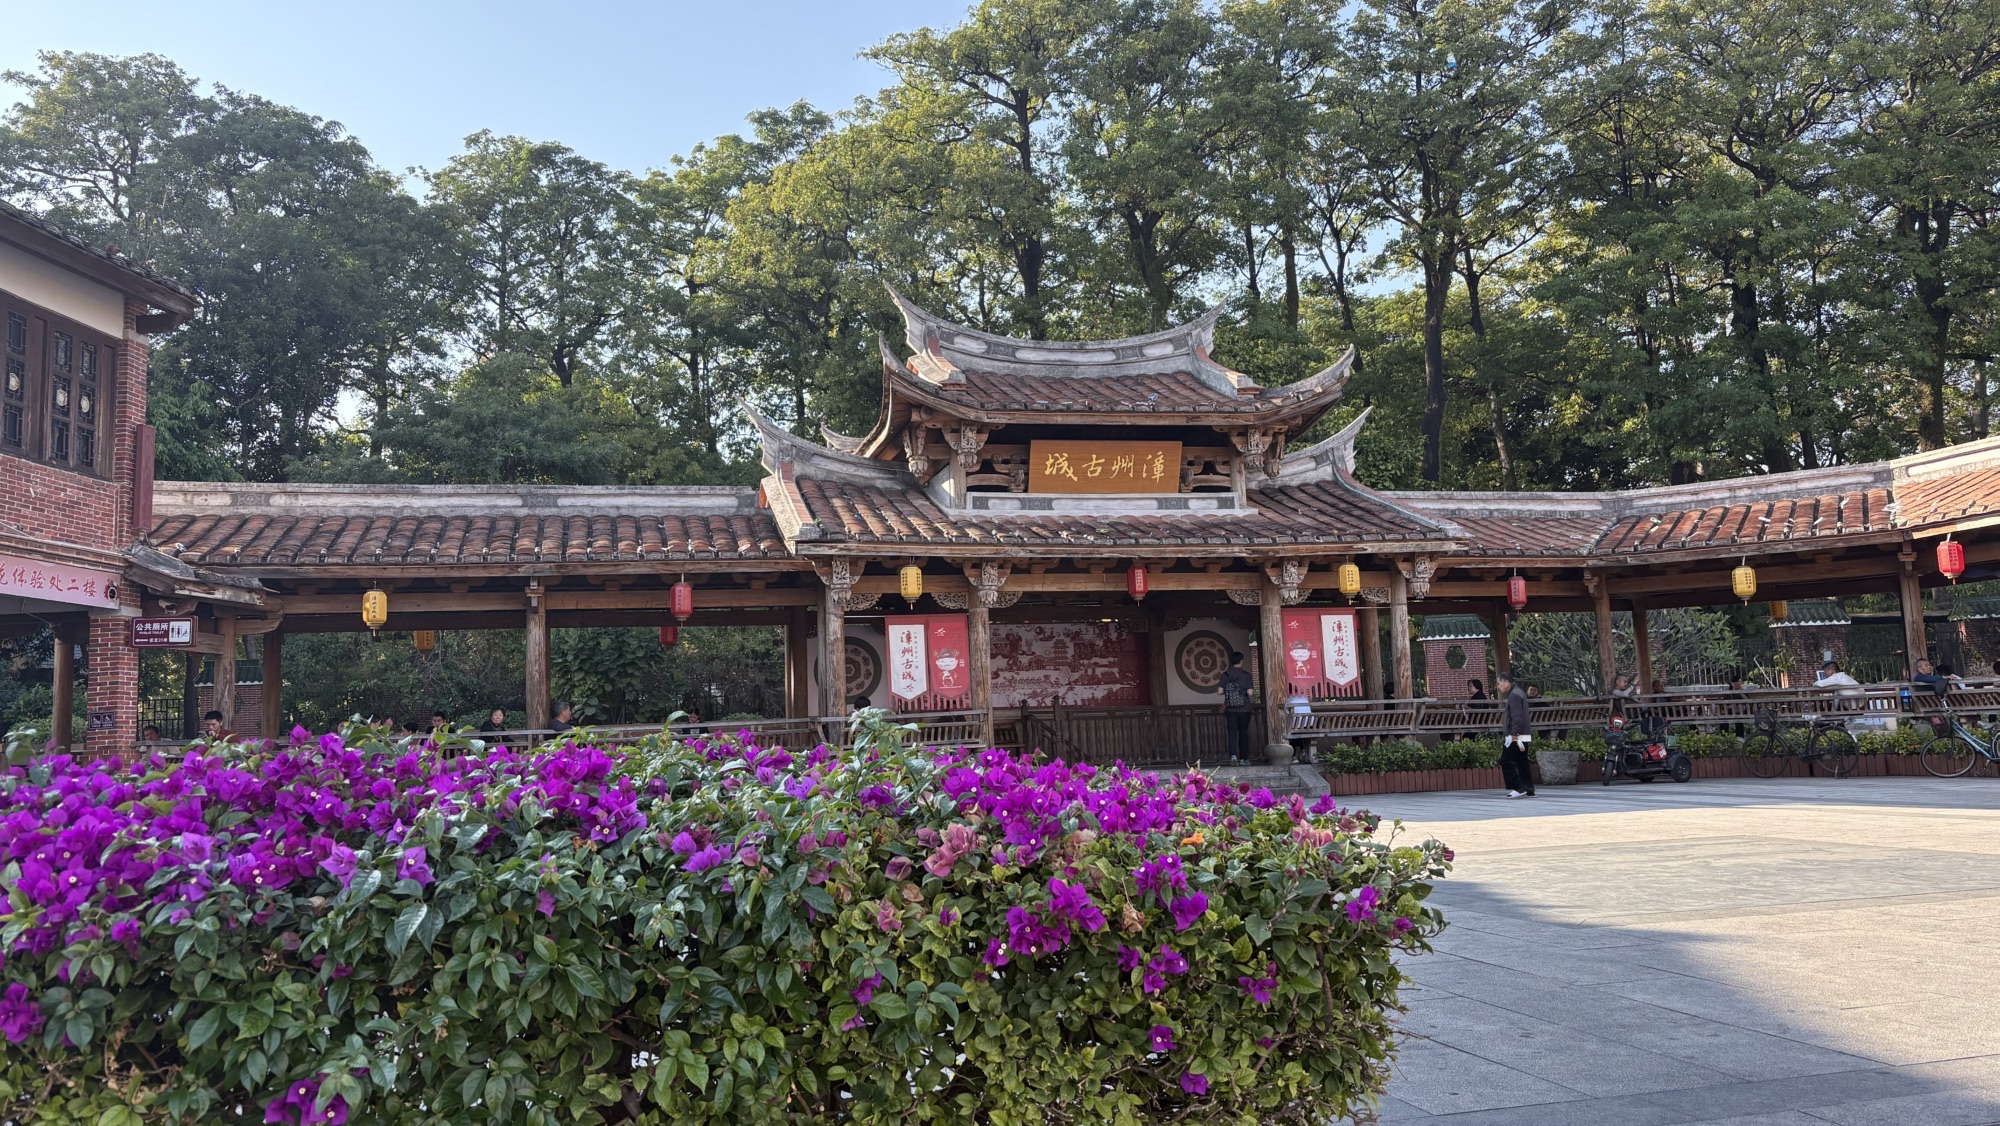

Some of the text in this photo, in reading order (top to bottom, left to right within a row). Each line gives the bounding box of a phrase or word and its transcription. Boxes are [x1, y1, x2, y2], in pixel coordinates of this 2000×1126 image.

[1044, 451, 1165, 483] 漳州古城
[135, 622, 169, 631] 公共厕所
[1332, 620, 1348, 669] 漳州古城
[900, 630, 917, 683] 漳州古城
